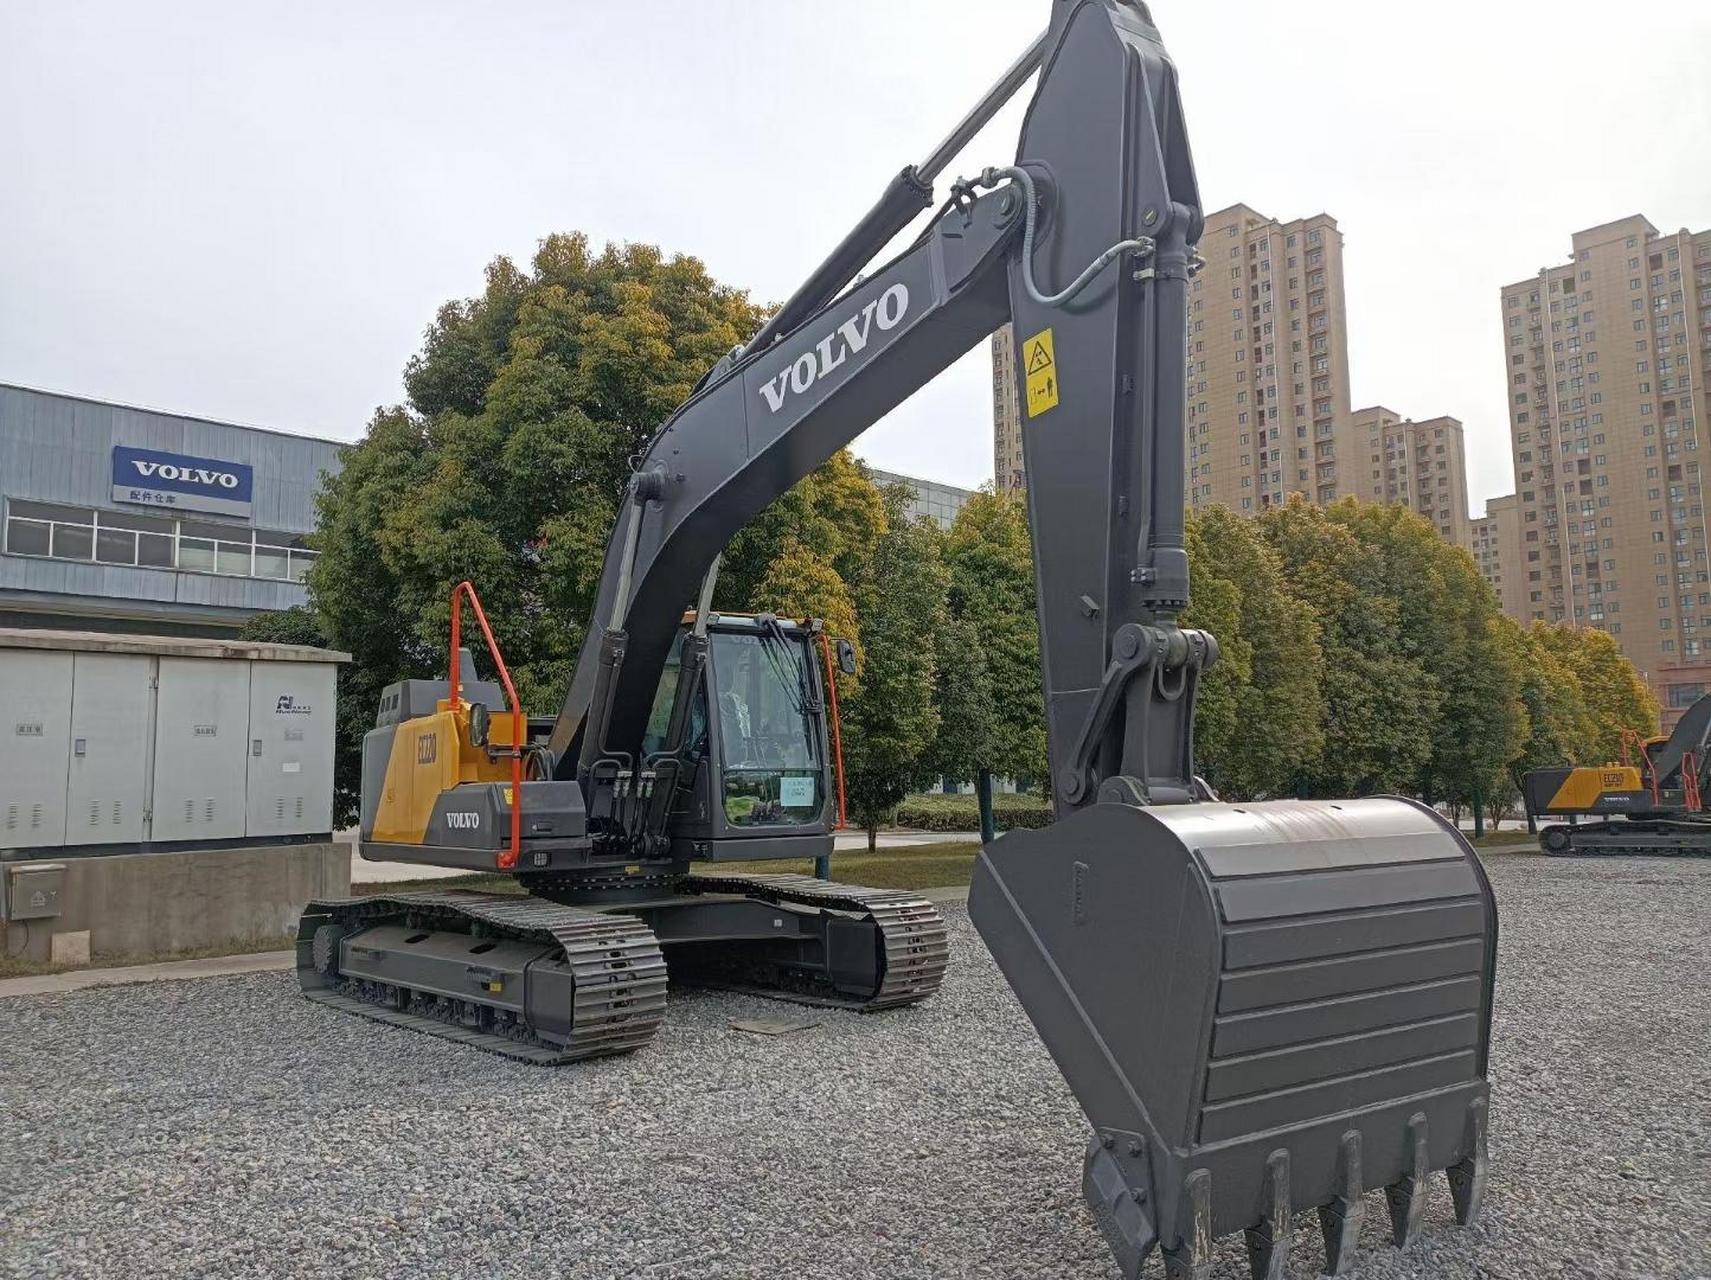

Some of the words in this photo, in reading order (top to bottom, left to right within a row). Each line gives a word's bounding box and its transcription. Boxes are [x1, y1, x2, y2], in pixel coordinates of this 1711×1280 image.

[759, 283, 909, 413] VOLVO
[131, 460, 238, 488] VOLVO
[418, 732, 437, 765] EC220
[446, 812, 479, 829] VOLVO
